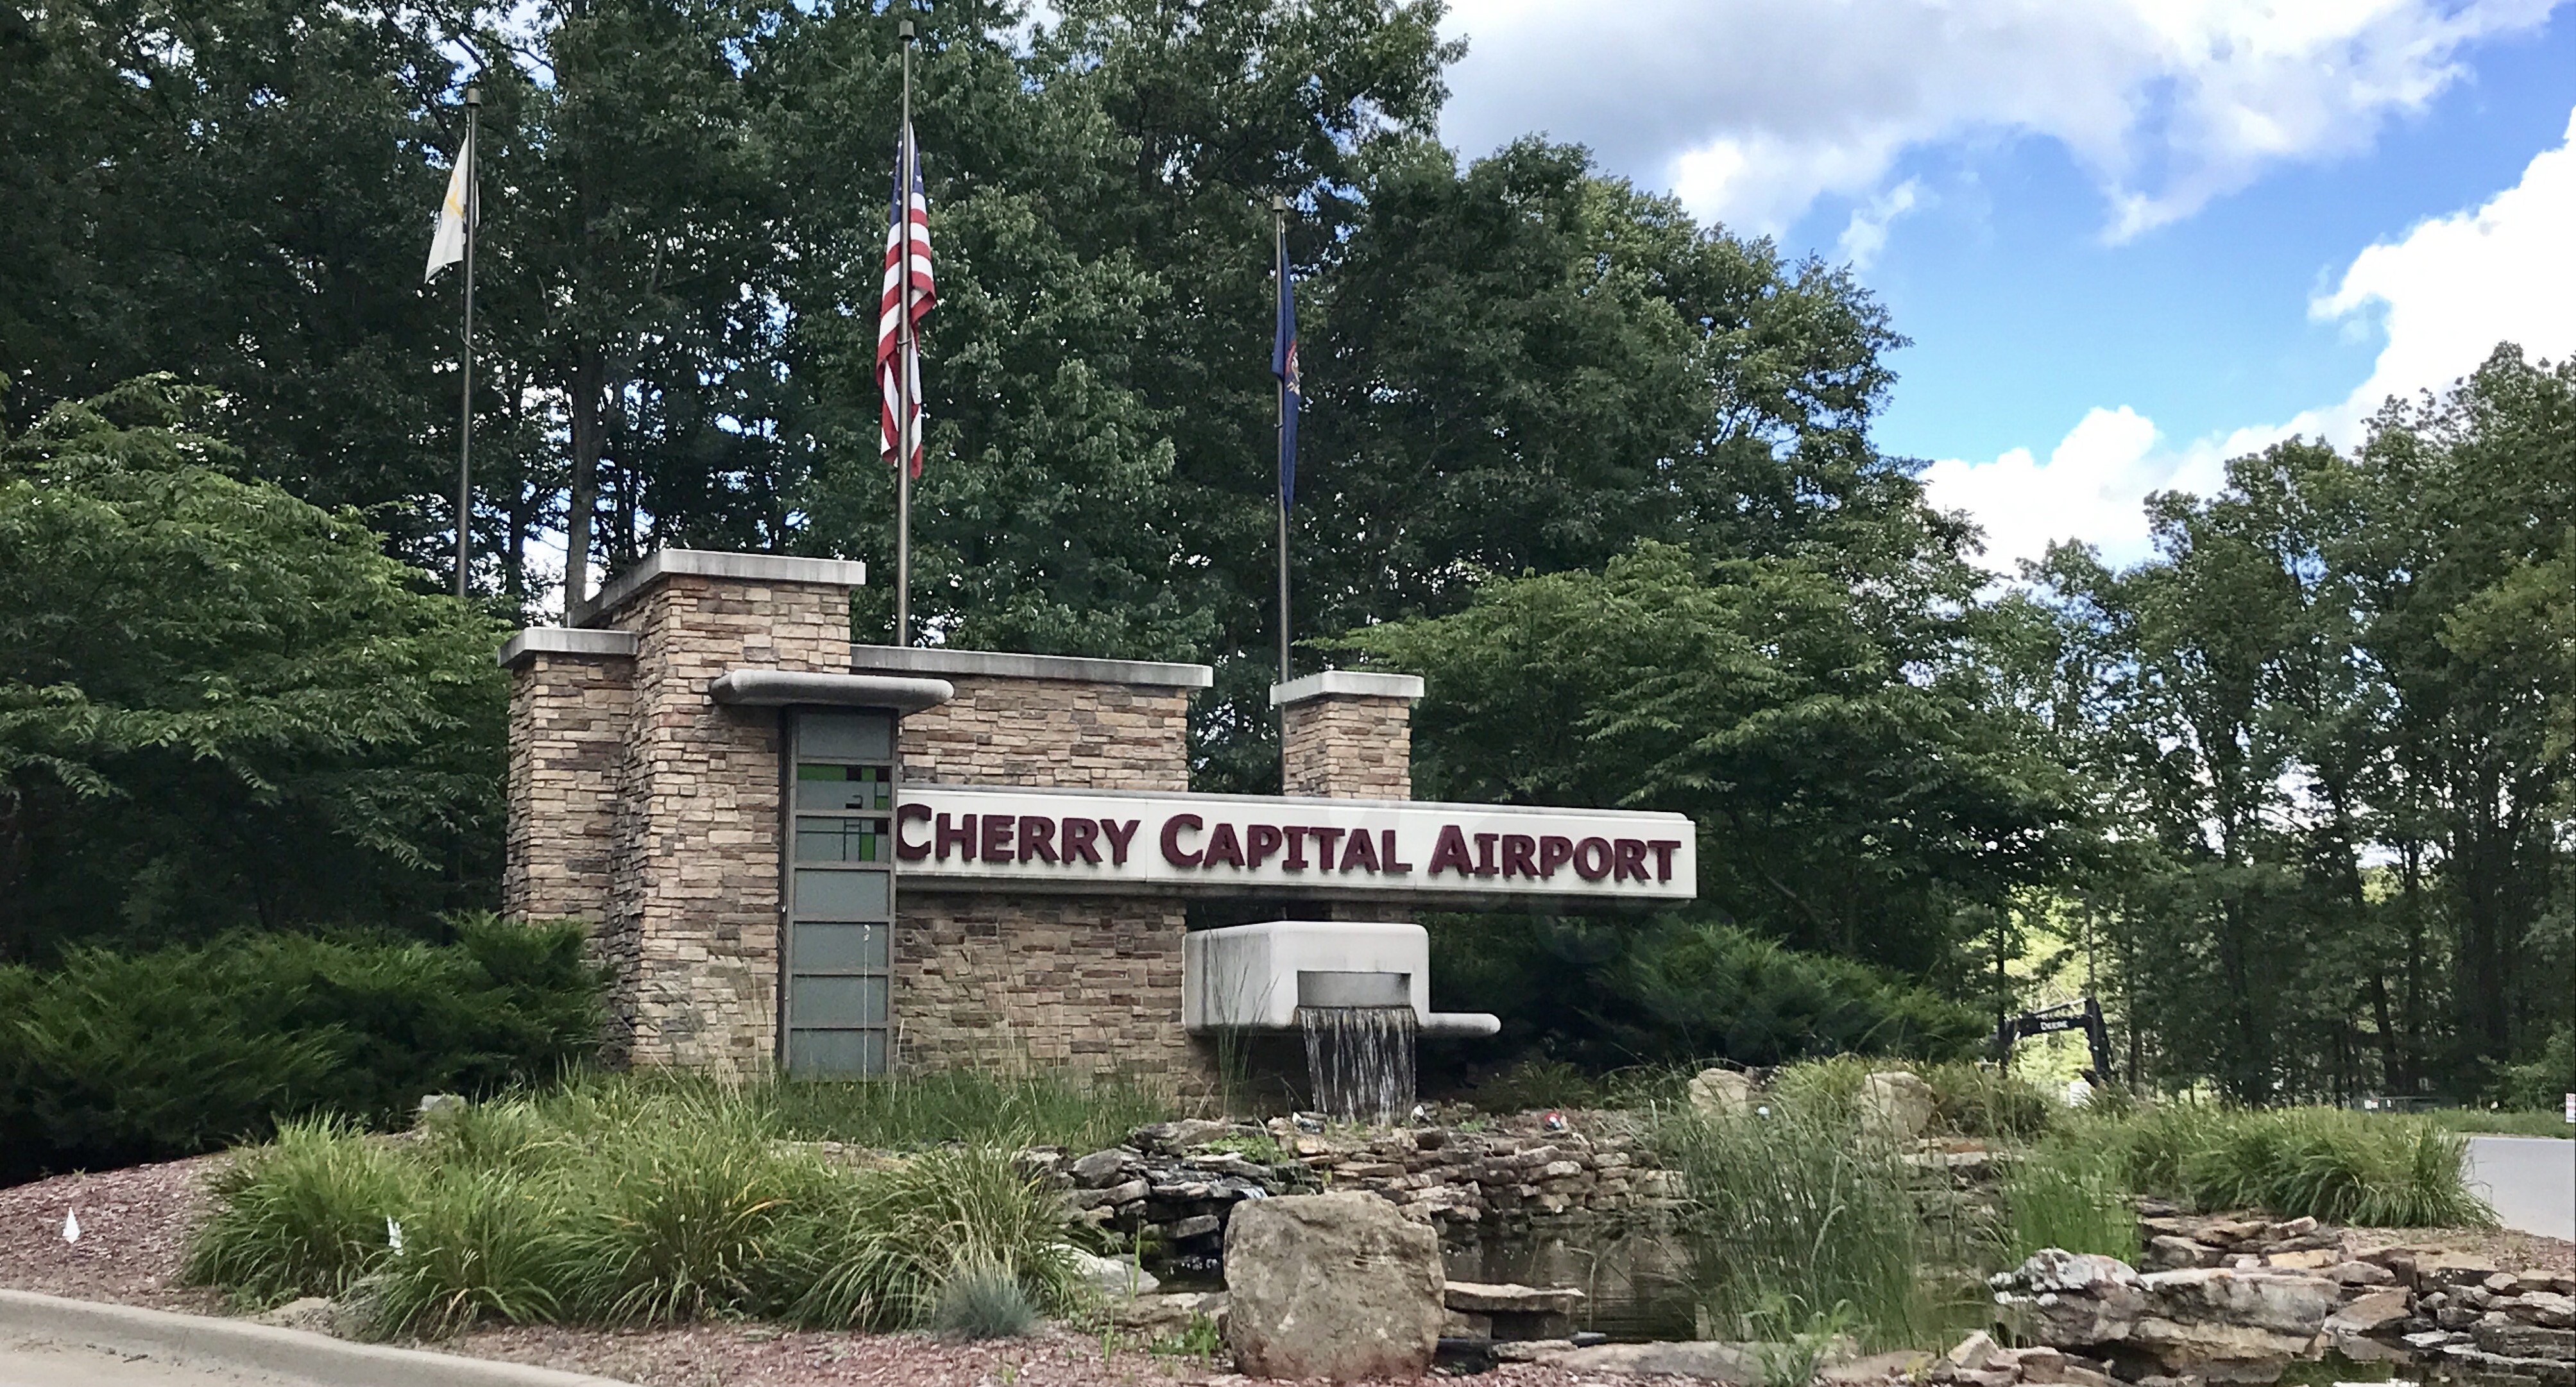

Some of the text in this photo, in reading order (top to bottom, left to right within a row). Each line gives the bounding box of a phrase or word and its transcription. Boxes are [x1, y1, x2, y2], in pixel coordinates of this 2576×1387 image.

[897, 803, 1682, 881] CHERRY CAPITAL AIRPORT
